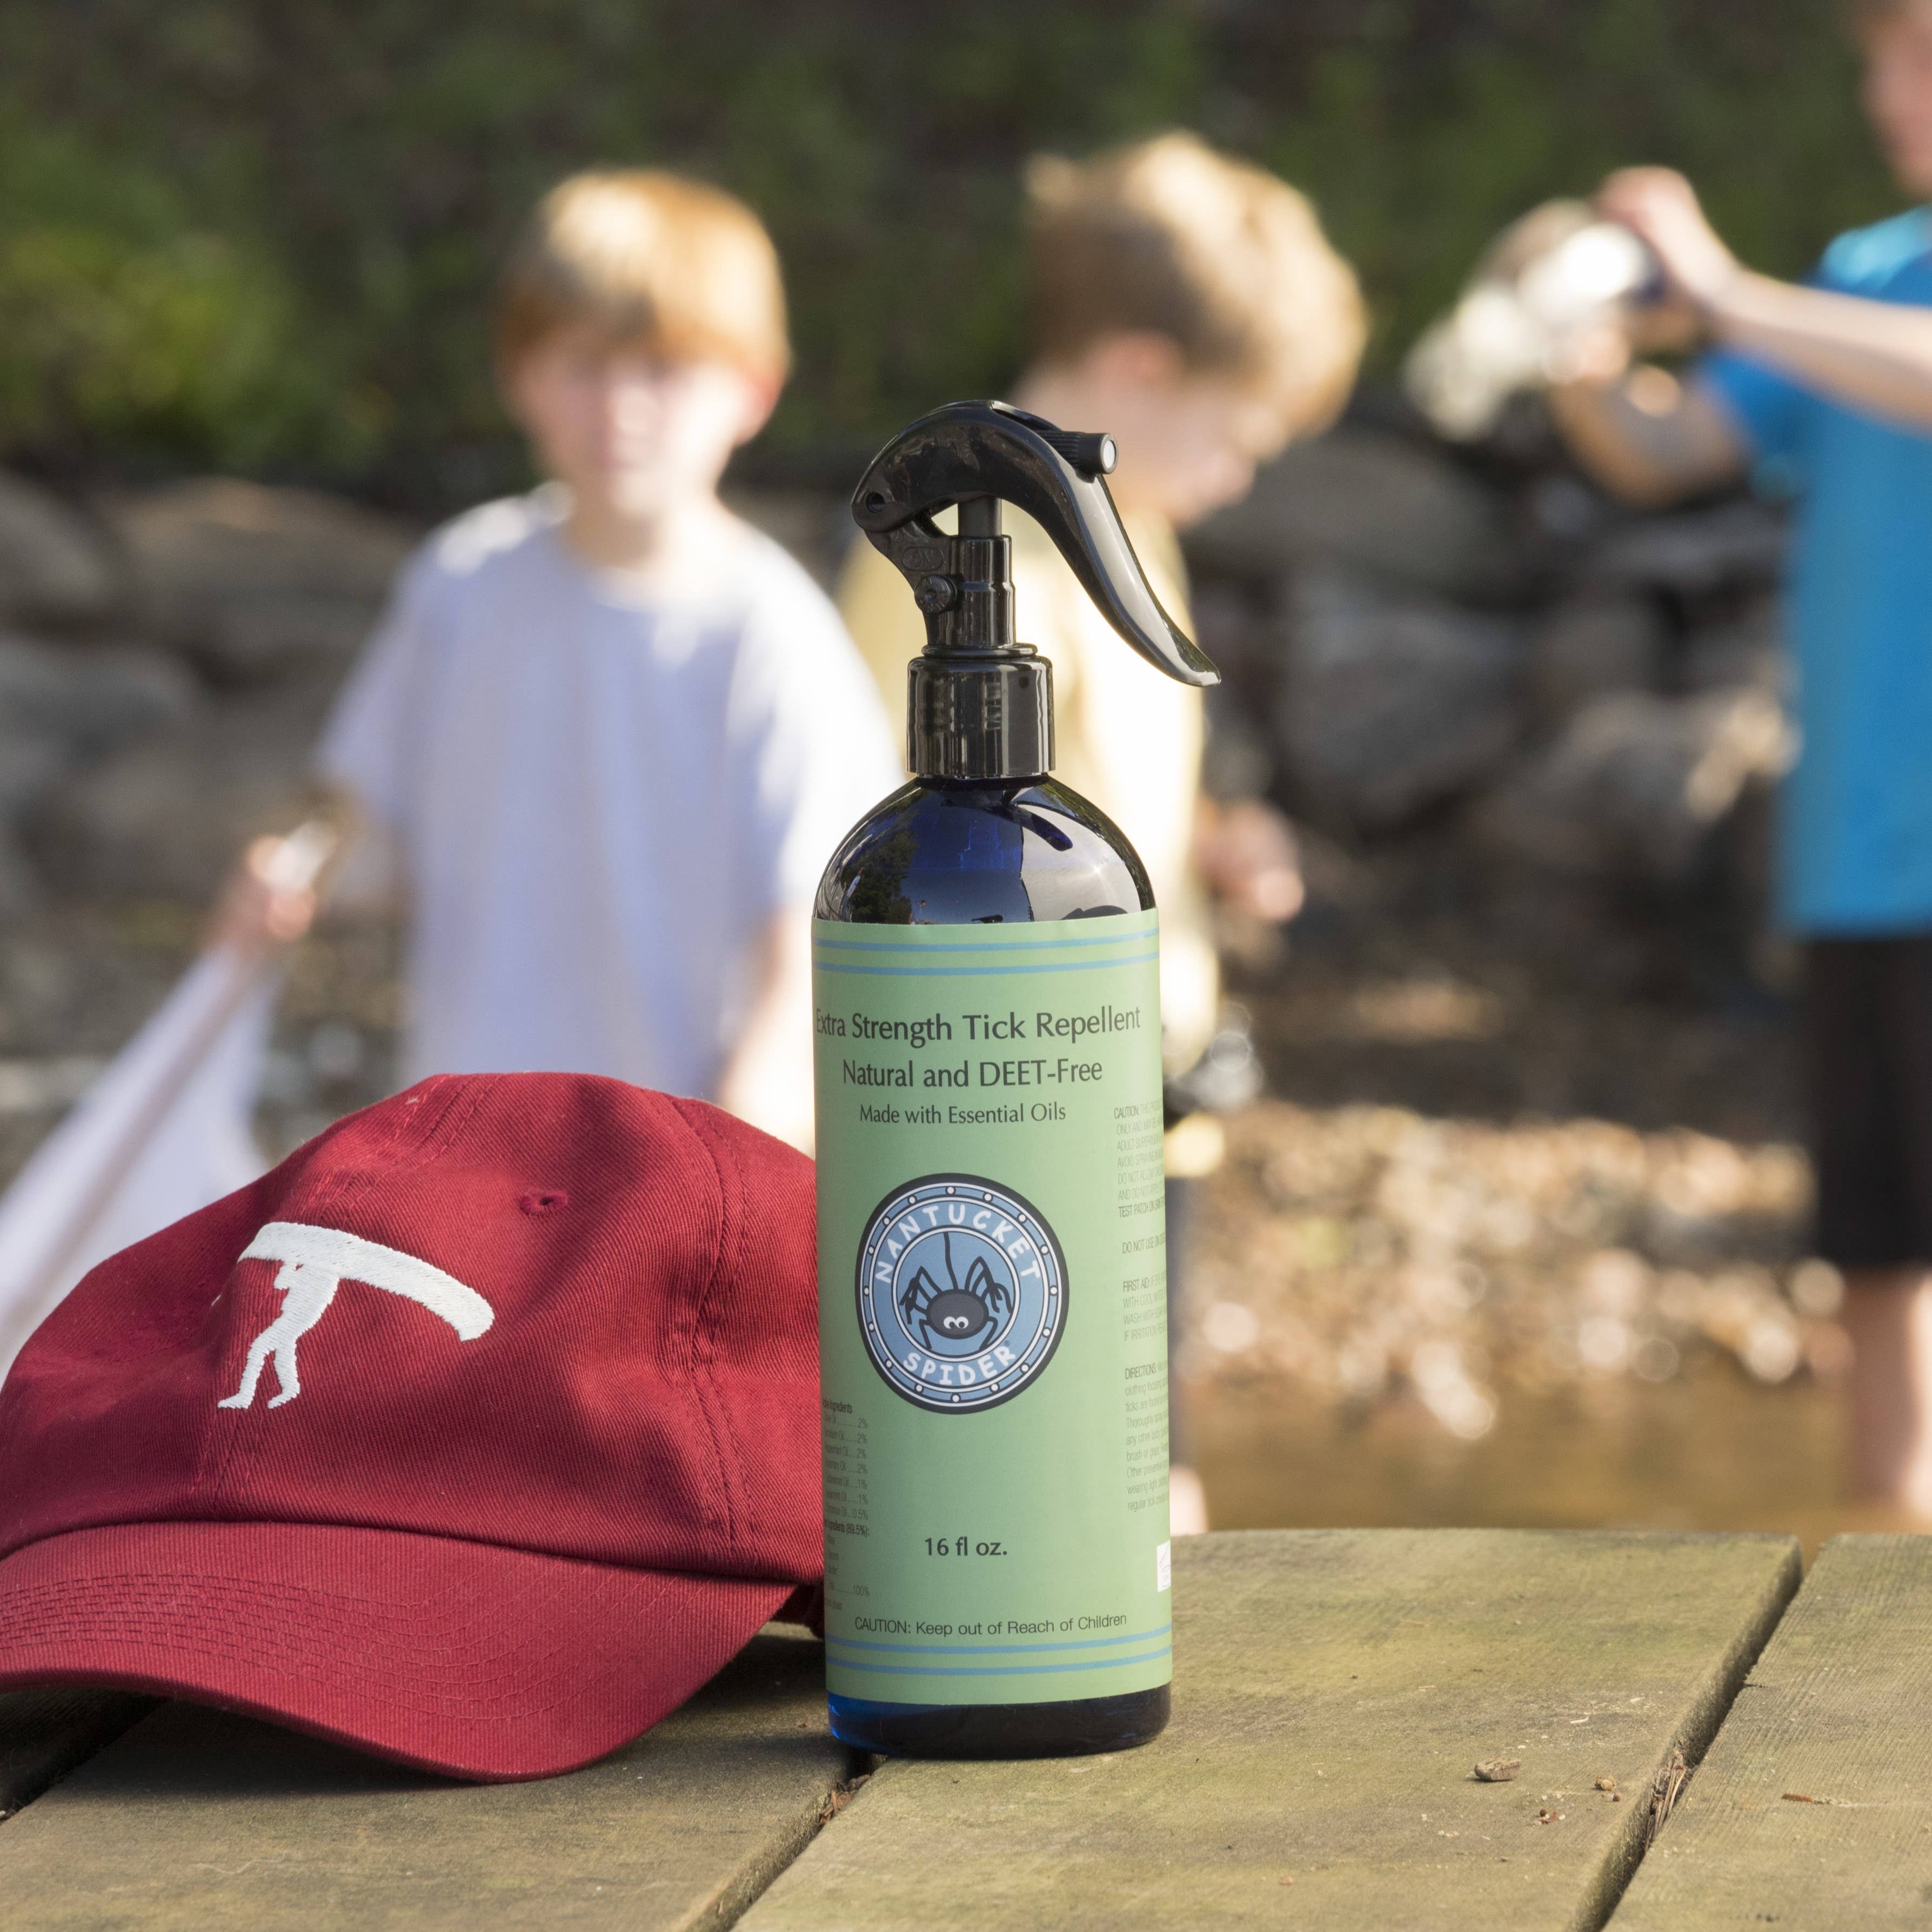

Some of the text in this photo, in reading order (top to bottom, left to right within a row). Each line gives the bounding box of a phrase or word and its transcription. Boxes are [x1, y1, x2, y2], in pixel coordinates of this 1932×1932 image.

[816, 1005, 1141, 1048] Extra Strength Tick Repellent
[843, 1059, 1102, 1087] Natural and DEET-Free
[860, 1101, 1066, 1124] Made with Essential Oils
[1117, 1123, 1132, 1135] ONLY
[1117, 1138, 1134, 1151] ADULT
[1117, 1155, 1134, 1167] AVOID
[1118, 1173, 1127, 1185] DO
[1118, 1205, 1133, 1218] TEST
[1134, 1202, 1148, 1215] PATCH
[875, 1204, 1040, 1283] NANTUCKET
[1122, 1241, 1132, 1254] DO
[1134, 1239, 1145, 1252] NOT
[1123, 1279, 1140, 1293] FIRST
[1123, 1297, 1139, 1308] WITH
[1124, 1312, 1141, 1325] WASH
[904, 1346, 1016, 1385] SPIDER
[925, 1536, 1007, 1556] 16 fl oz.
[855, 1614, 1127, 1637] CAUTION: Keep out of Reach of Children
